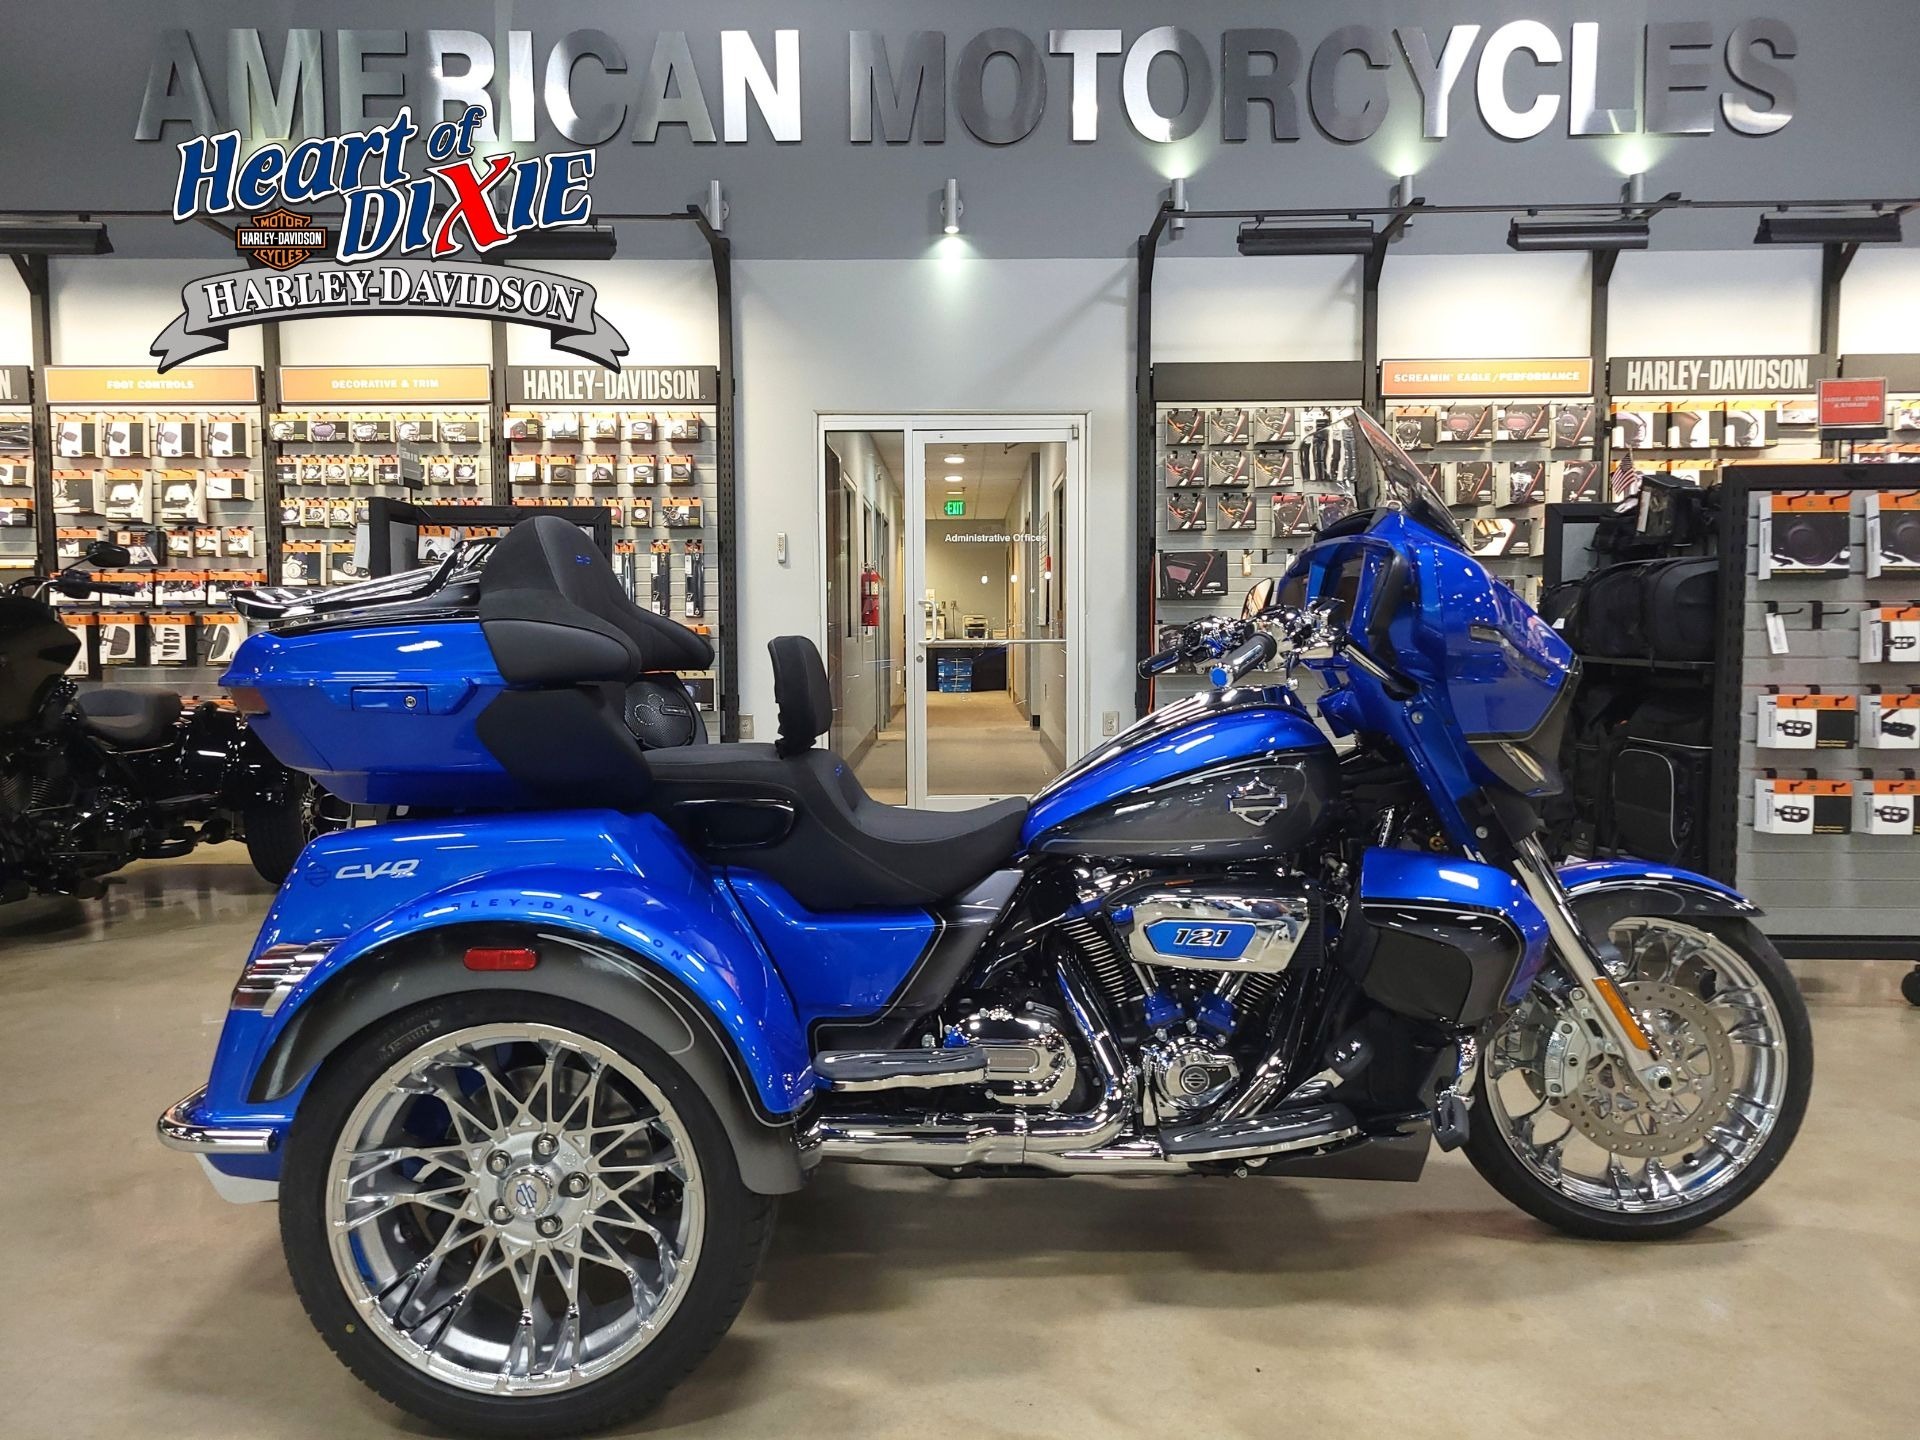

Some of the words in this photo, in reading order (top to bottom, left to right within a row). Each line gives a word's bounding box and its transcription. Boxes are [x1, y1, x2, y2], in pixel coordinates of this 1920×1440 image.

[134, 28, 801, 144] AMERICAN
[849, 19, 1797, 145] MOTORCYCLES
[331, 378, 398, 390] DECORATIVE
[413, 378, 440, 389] TRIM
[523, 369, 700, 400] HARLEY-DAVIDSON
[1626, 358, 1809, 392] HARLEY-DAVIDSON
[947, 501, 964, 515] EXIT
[944, 533, 1011, 543] Administrative
[1012, 533, 1047, 543] Offices
[1173, 928, 1232, 947] 121
